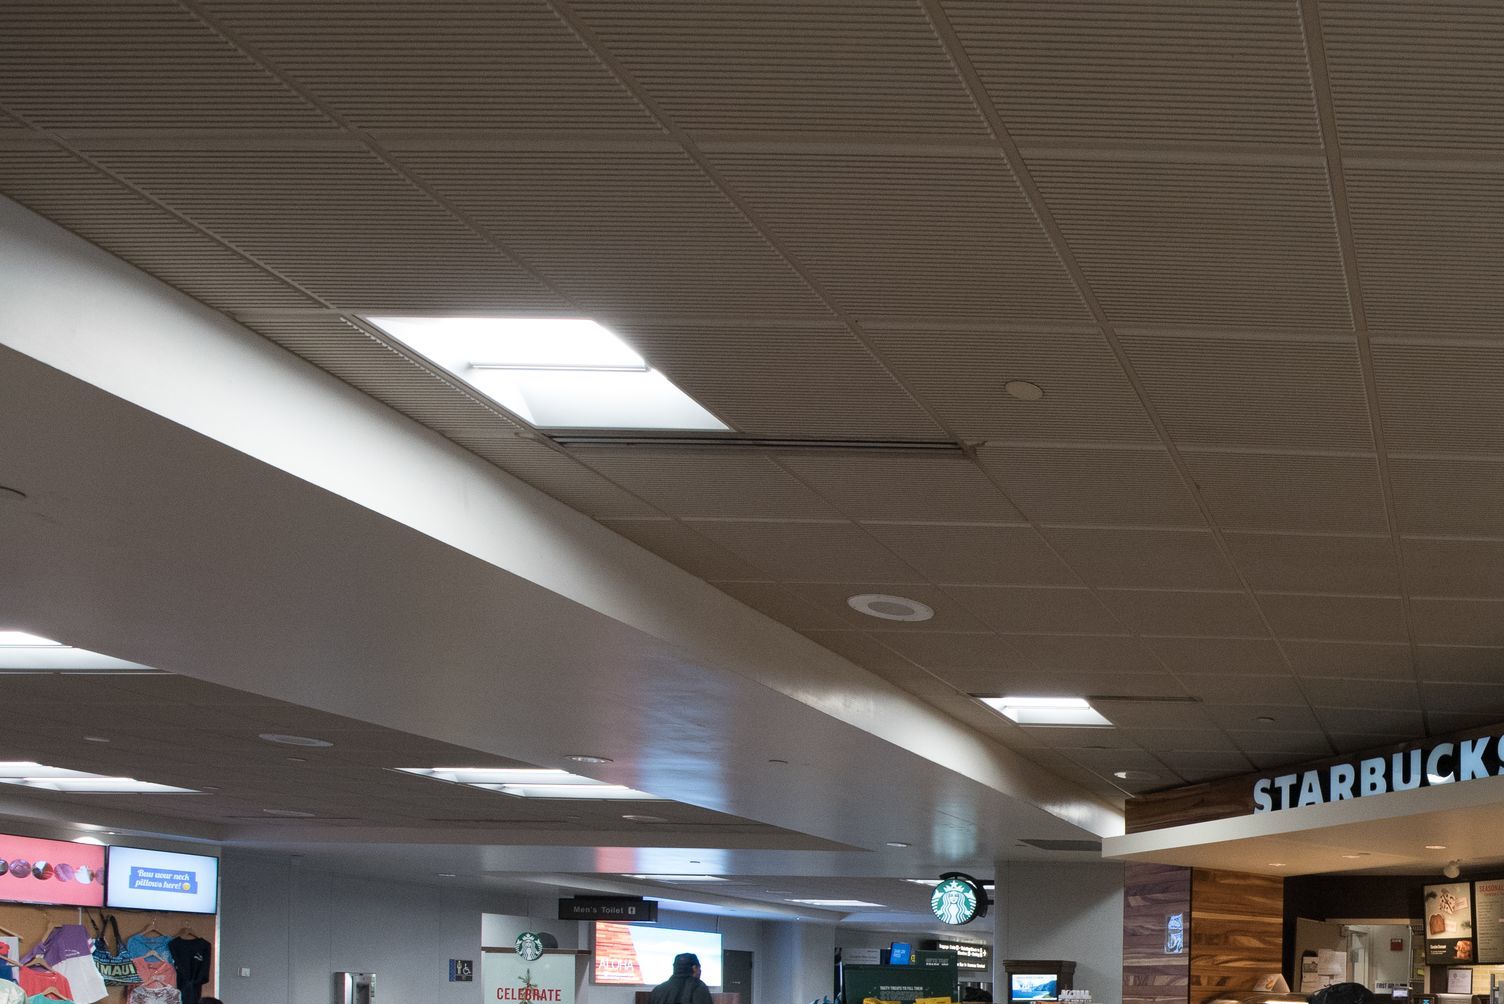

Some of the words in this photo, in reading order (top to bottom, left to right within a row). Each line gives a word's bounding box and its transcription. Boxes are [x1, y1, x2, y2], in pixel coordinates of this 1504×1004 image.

[173, 873, 190, 881] neck
[135, 879, 162, 888] pillows
[601, 906, 624, 914] Toilet
[101, 963, 137, 977] MAUI
[598, 959, 634, 972] ALOHA
[496, 987, 562, 1002] CELEBRATE
